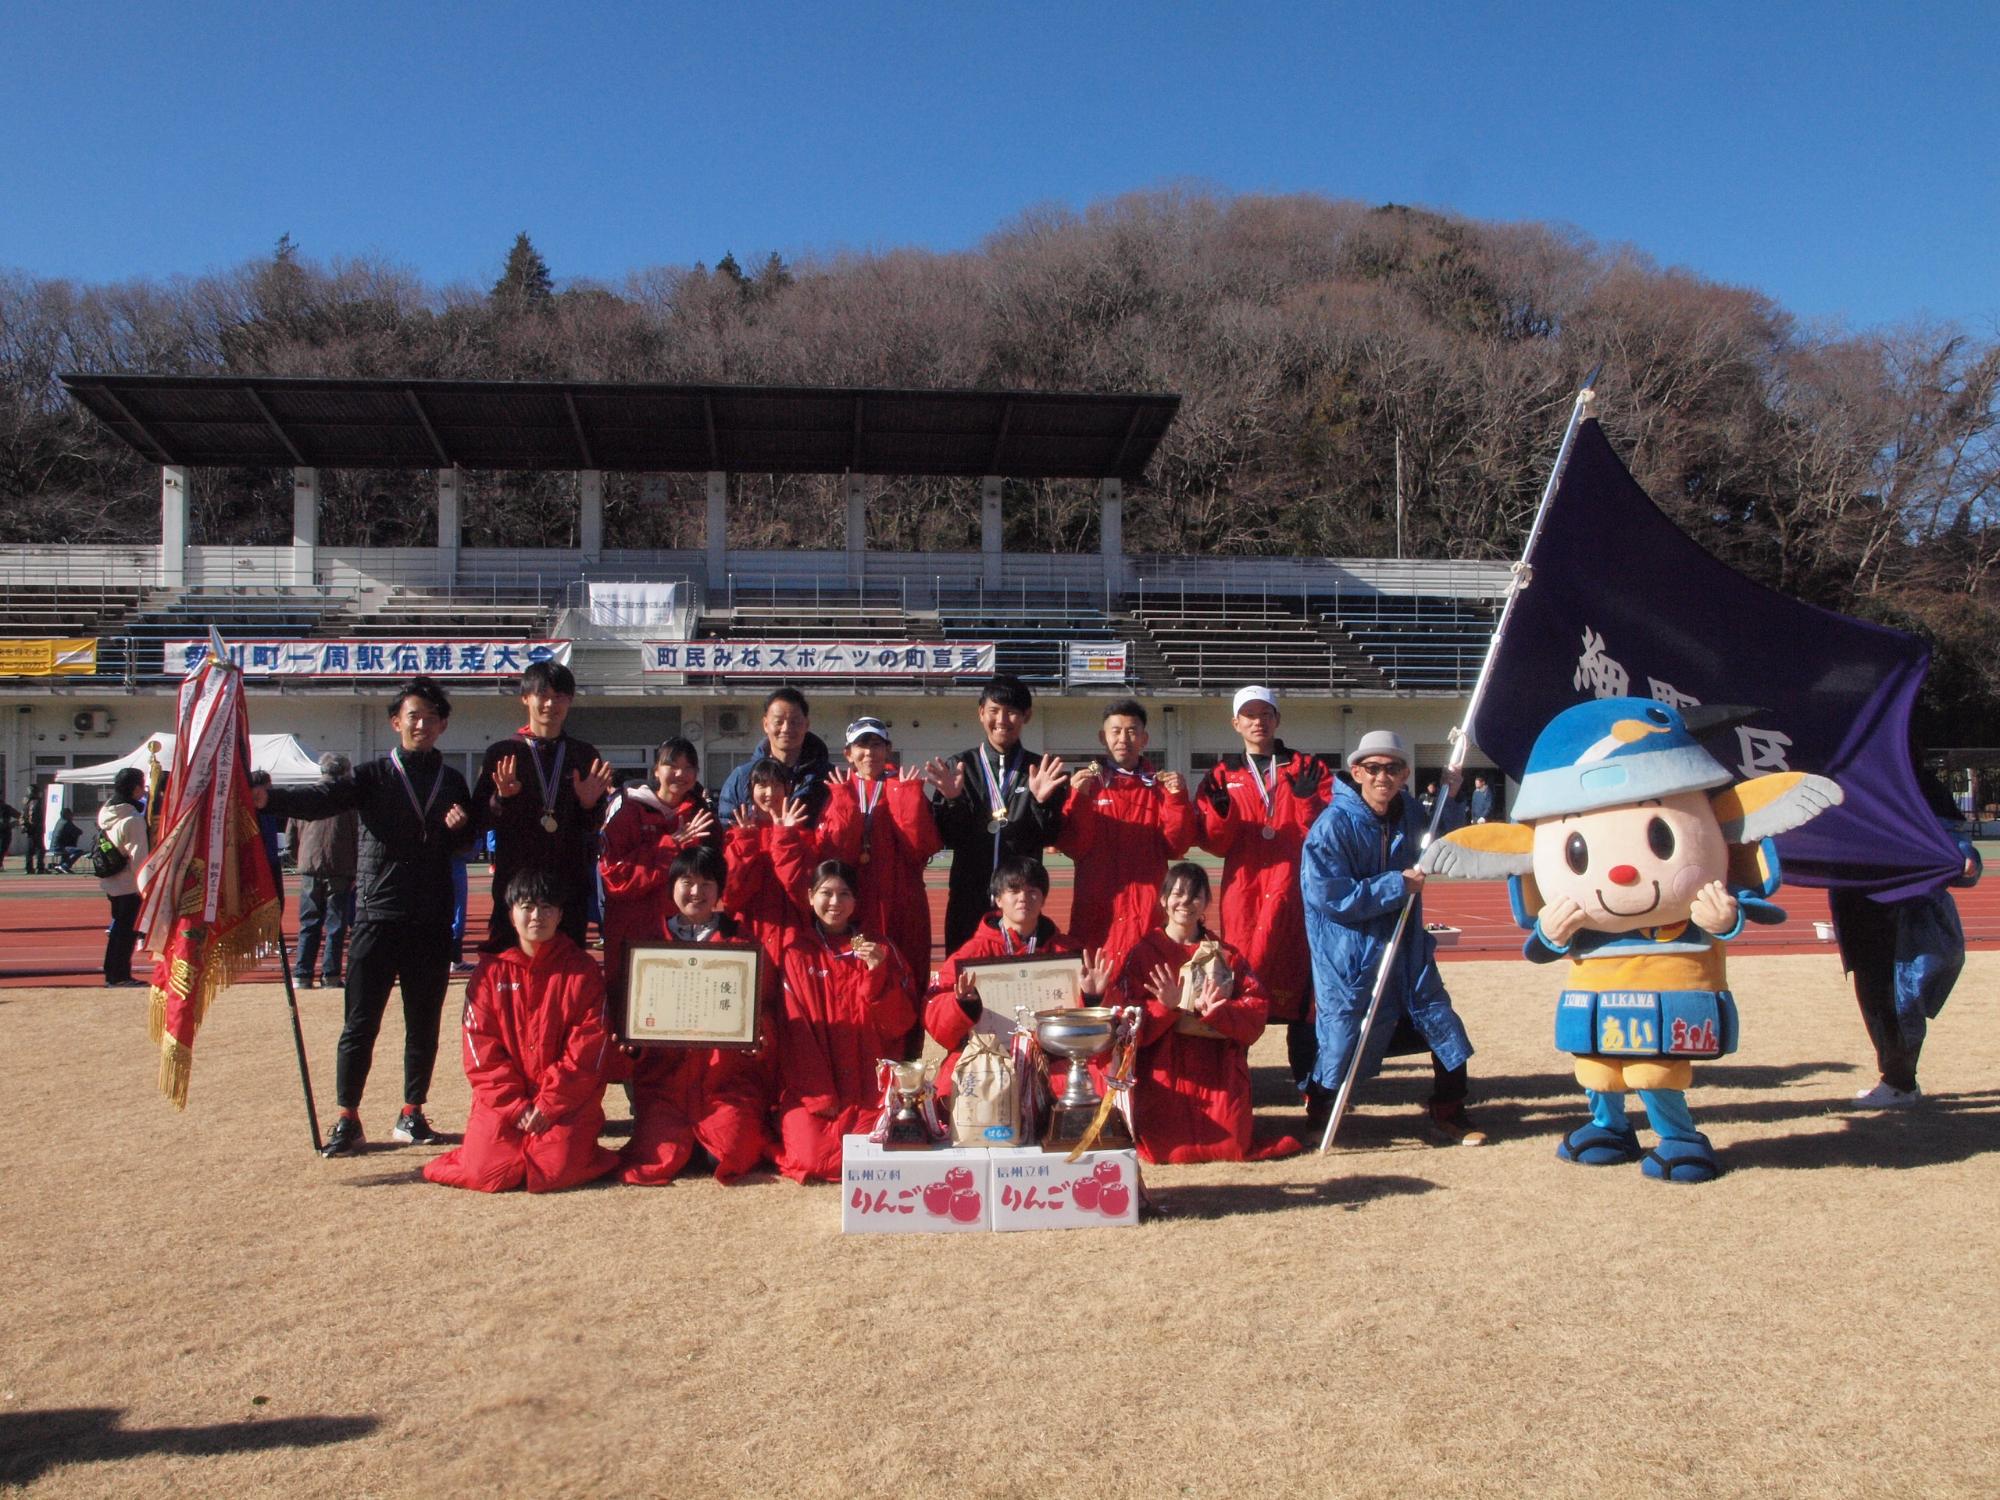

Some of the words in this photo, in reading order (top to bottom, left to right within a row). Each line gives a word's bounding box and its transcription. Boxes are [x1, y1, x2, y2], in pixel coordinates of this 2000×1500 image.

[657, 646, 981, 669] 町民みなスポーツの町宣言
[720, 981, 734, 1012] 優勝
[1563, 993, 1589, 1007] TOWN
[1601, 993, 1655, 1007] AIKAWA
[1602, 1016, 1653, 1049] あい
[1671, 1017, 1718, 1051] ちゃん
[848, 1168, 901, 1181] 信州立科
[997, 1165, 1050, 1178] 信州立科
[851, 1185, 922, 1214] りんご
[1001, 1181, 1071, 1212] りんご
